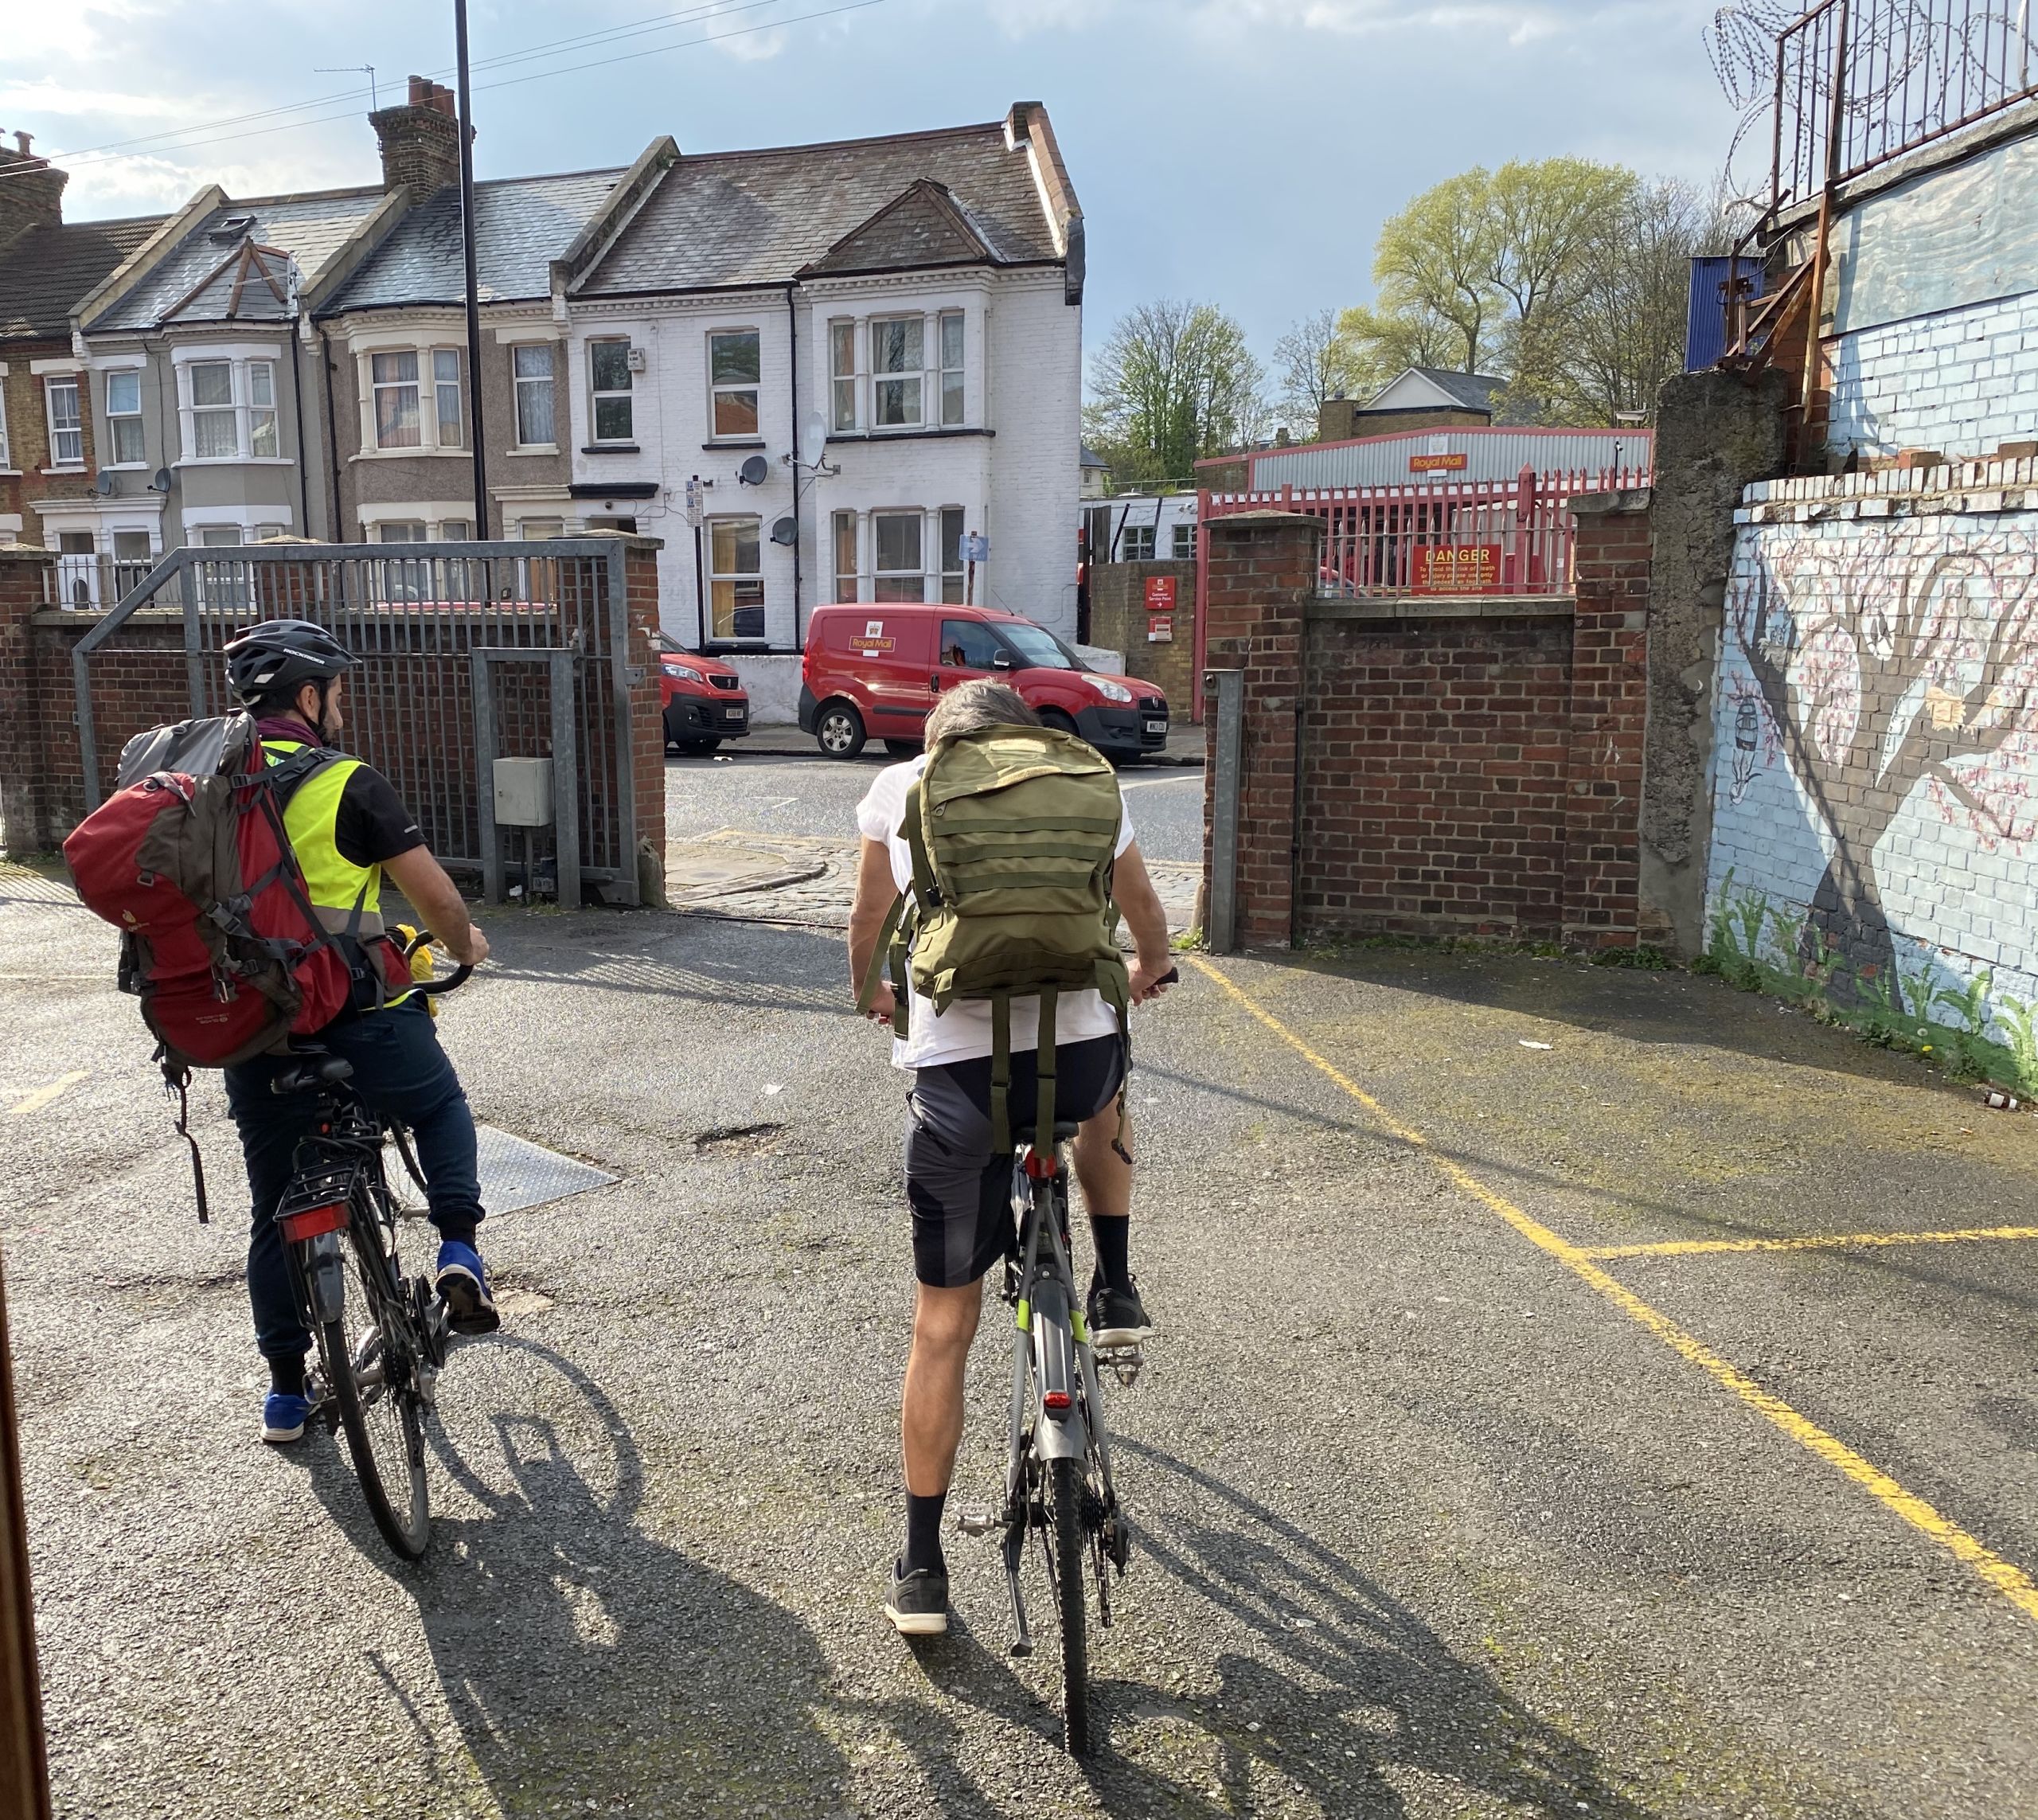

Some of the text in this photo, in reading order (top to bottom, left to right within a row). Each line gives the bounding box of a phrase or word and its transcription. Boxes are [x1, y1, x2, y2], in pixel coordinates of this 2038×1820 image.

[1414, 456, 1462, 468] Royal Mail
[1426, 549, 1489, 561] DANGER
[853, 639, 892, 649] Royal Mail
[283, 648, 326, 665] ROCKRIDER
